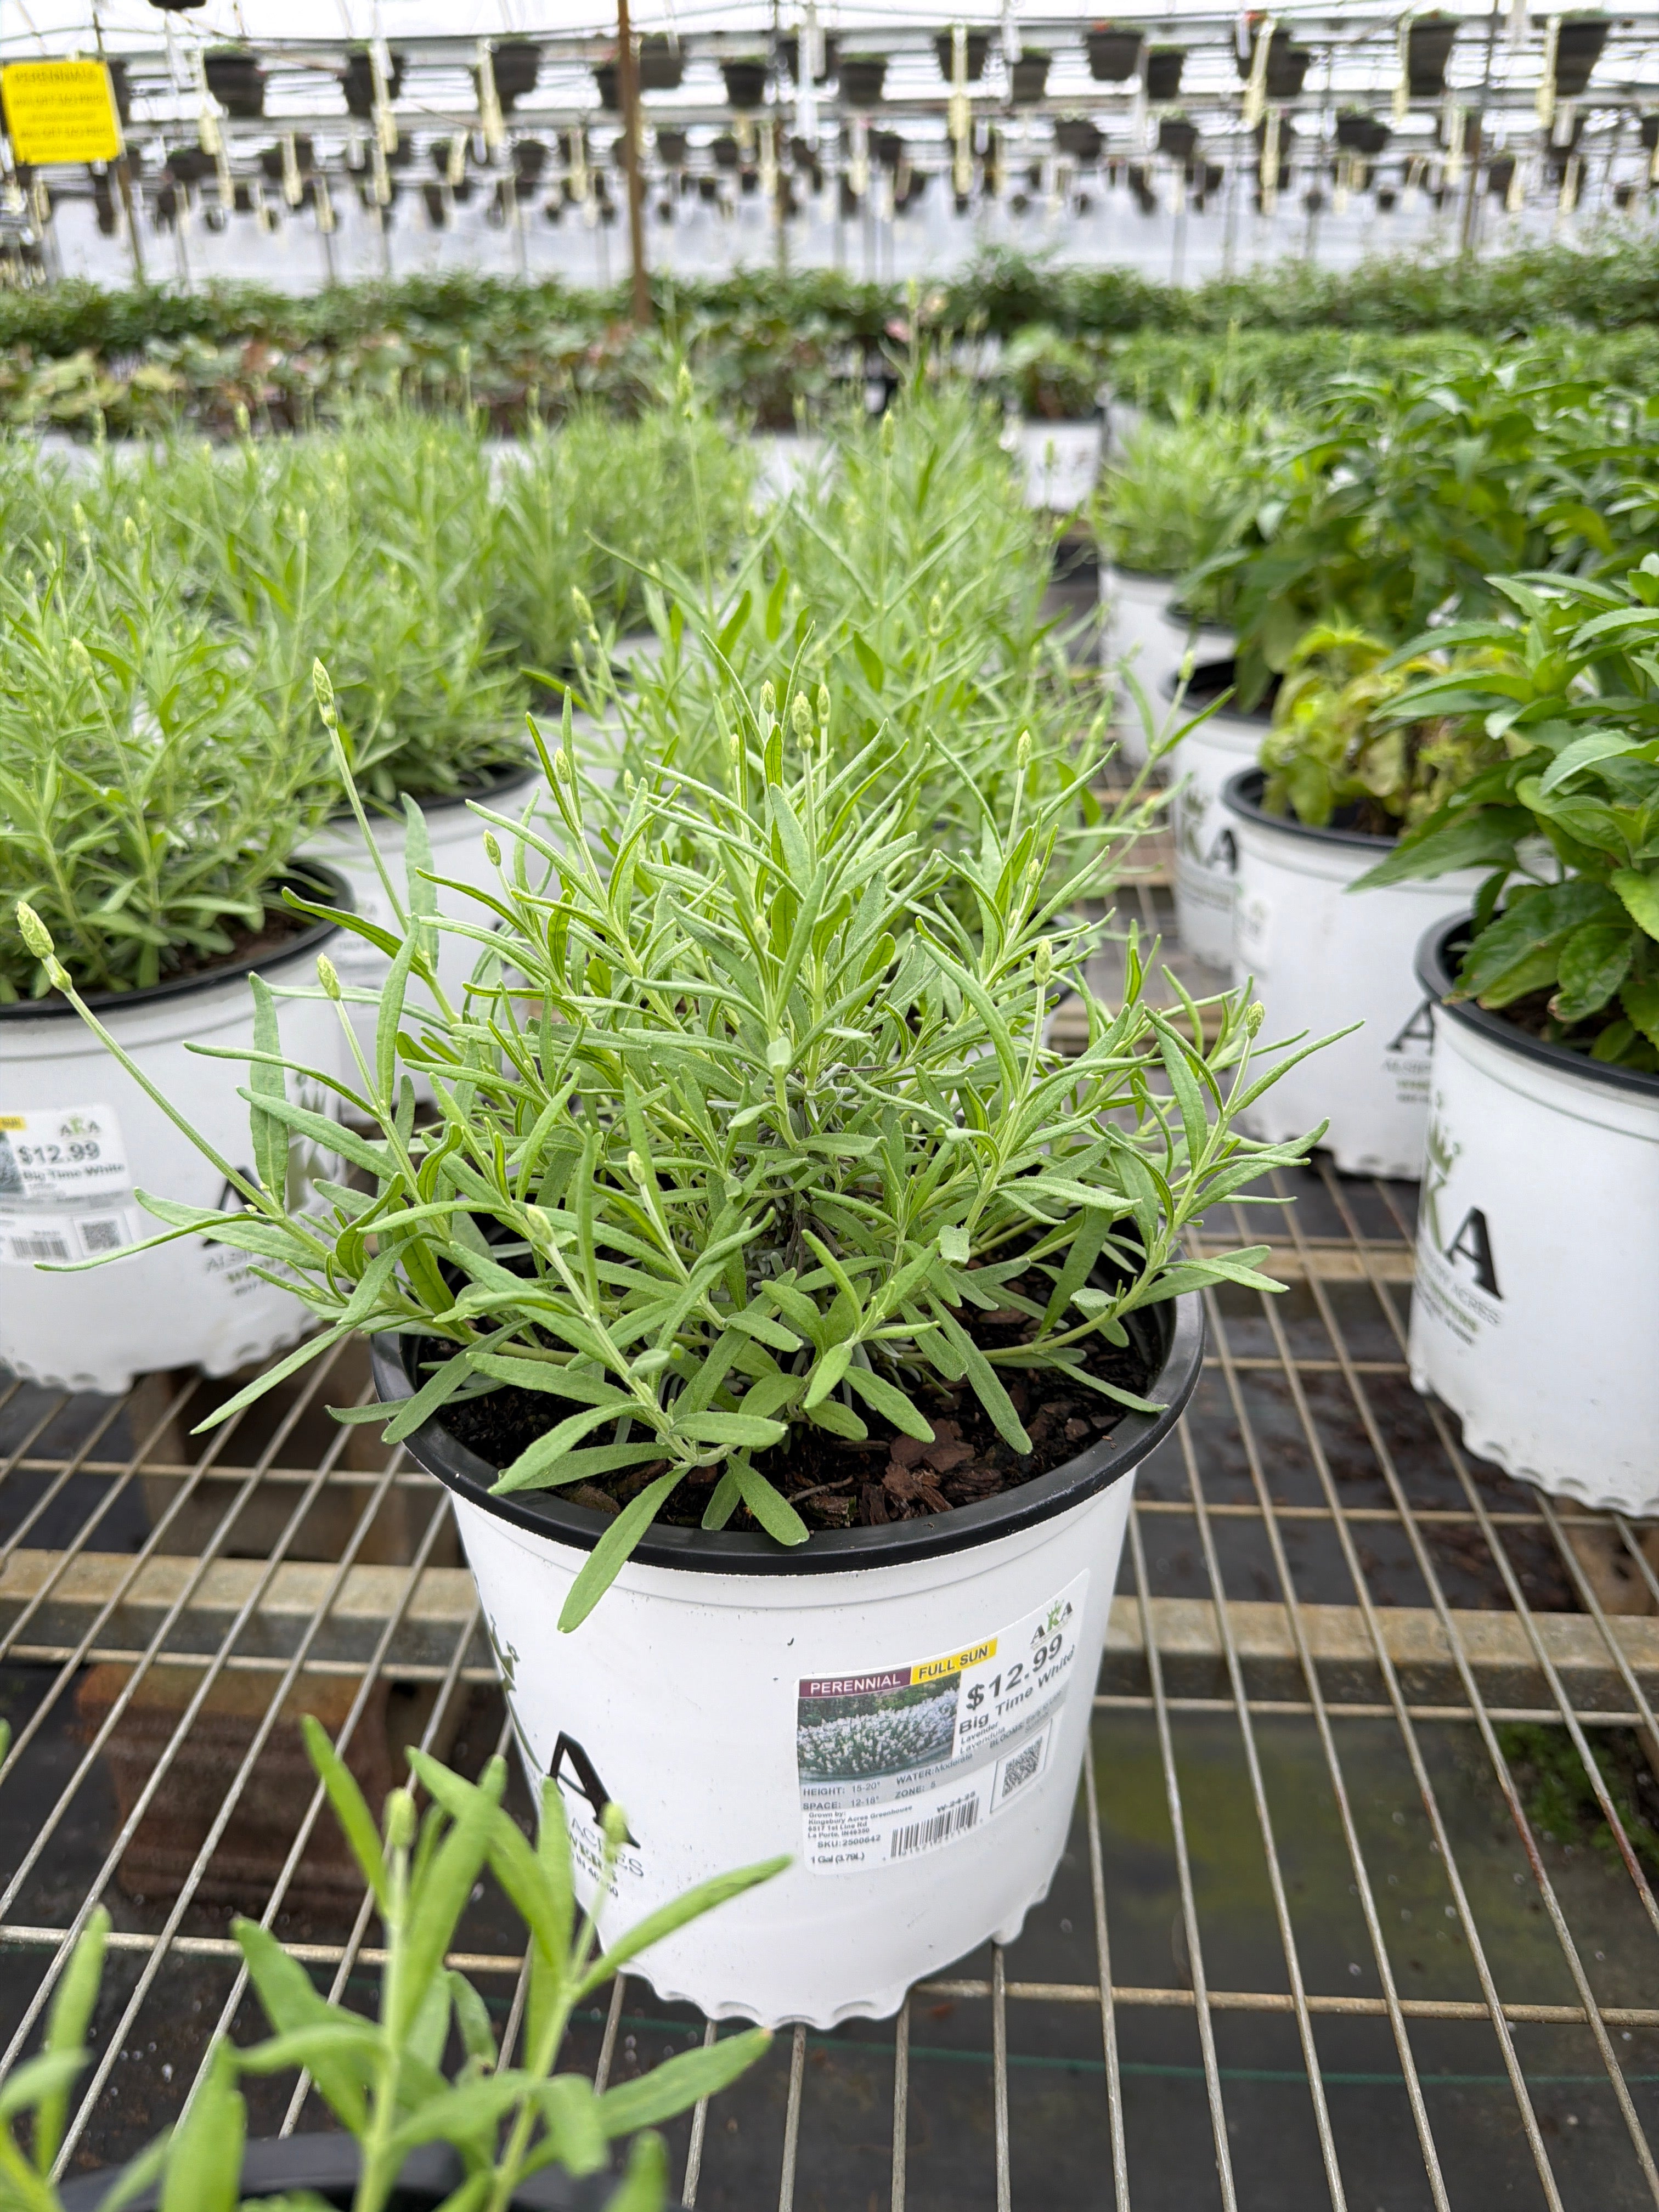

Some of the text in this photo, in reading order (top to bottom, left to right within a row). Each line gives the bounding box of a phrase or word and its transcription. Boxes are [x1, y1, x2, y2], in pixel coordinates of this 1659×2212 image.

[17, 1140, 100, 1165] $12.99
[1030, 1599, 1073, 1645] AKA
[918, 1646, 988, 1679] FULL SUN
[966, 1633, 1063, 1711] $12.99
[810, 1673, 901, 1696] PERENNIAL
[959, 1713, 989, 1735] Big
[995, 1686, 1033, 1716] Time
[960, 1726, 1006, 1754] Lavendula
[961, 1721, 998, 1745] Lavender
[803, 1786, 845, 1797] HEIGHT:
[895, 1785, 924, 1799] ZONE:
[803, 1801, 841, 1810] SPACE:
[870, 1805, 913, 1819] Greenhouse
[817, 1854, 833, 1863] Gal
